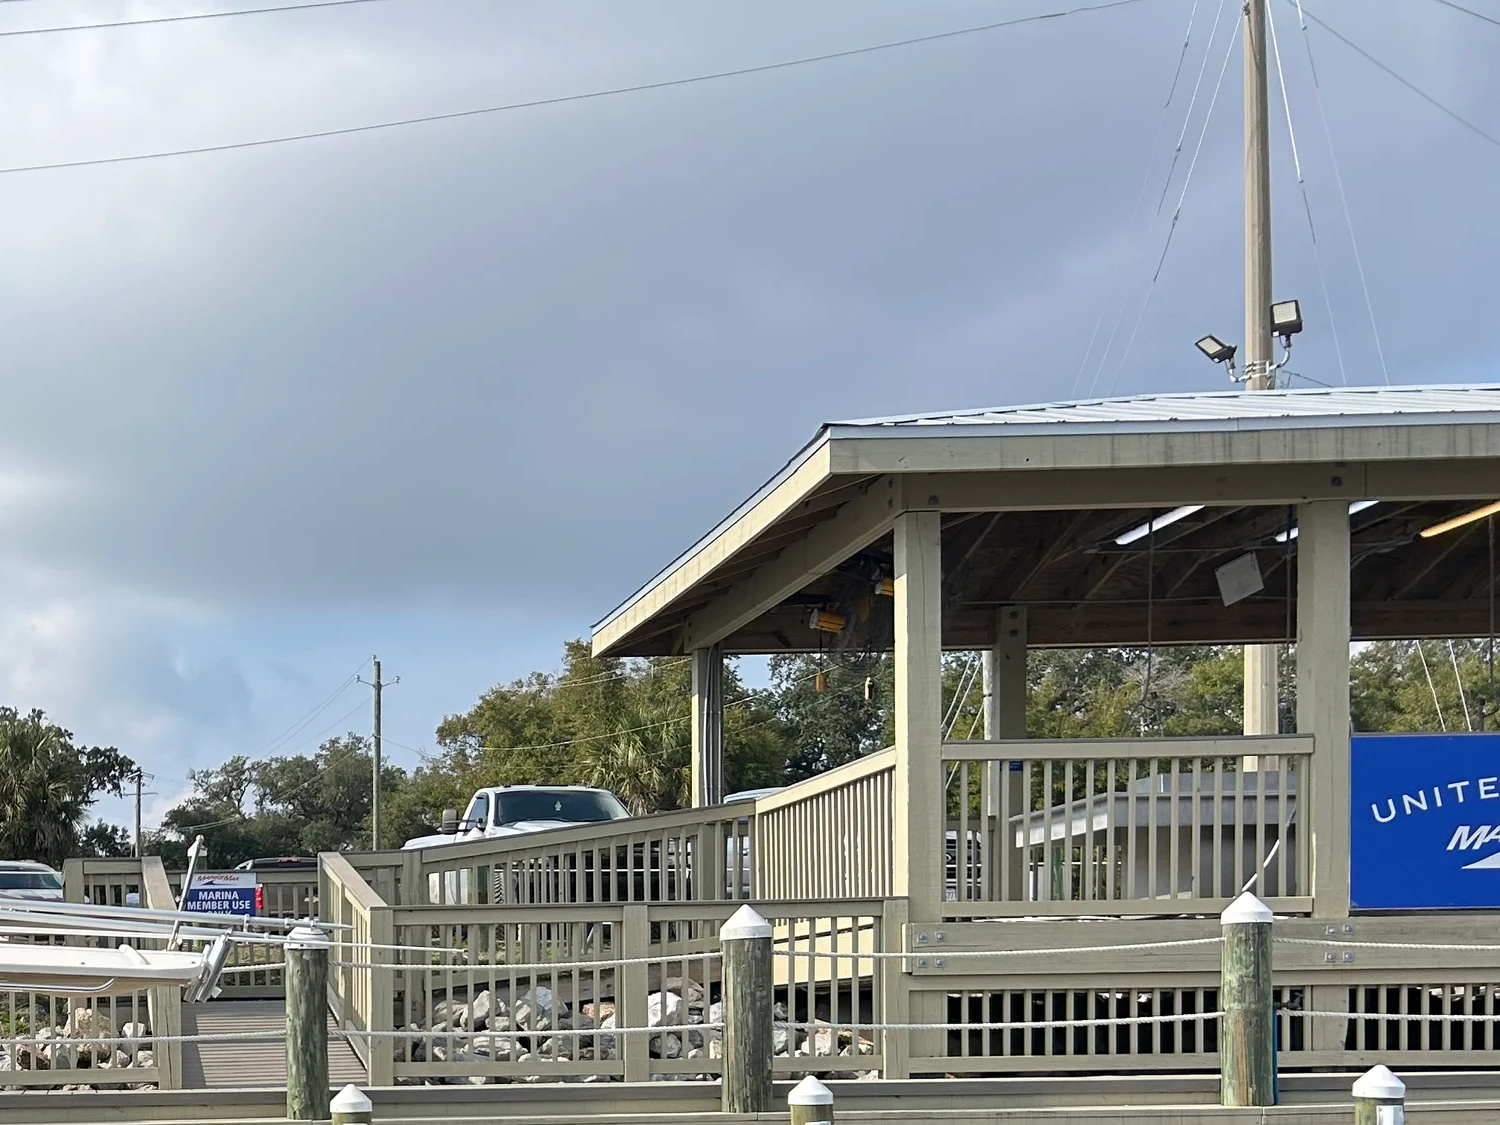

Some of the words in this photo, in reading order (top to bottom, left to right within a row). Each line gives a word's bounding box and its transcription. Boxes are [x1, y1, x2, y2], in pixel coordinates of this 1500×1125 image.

[1371, 777, 1500, 822] UNITE
[199, 891, 239, 900] MARINA
[187, 901, 229, 910] MEMBER
[232, 900, 251, 910] USE
